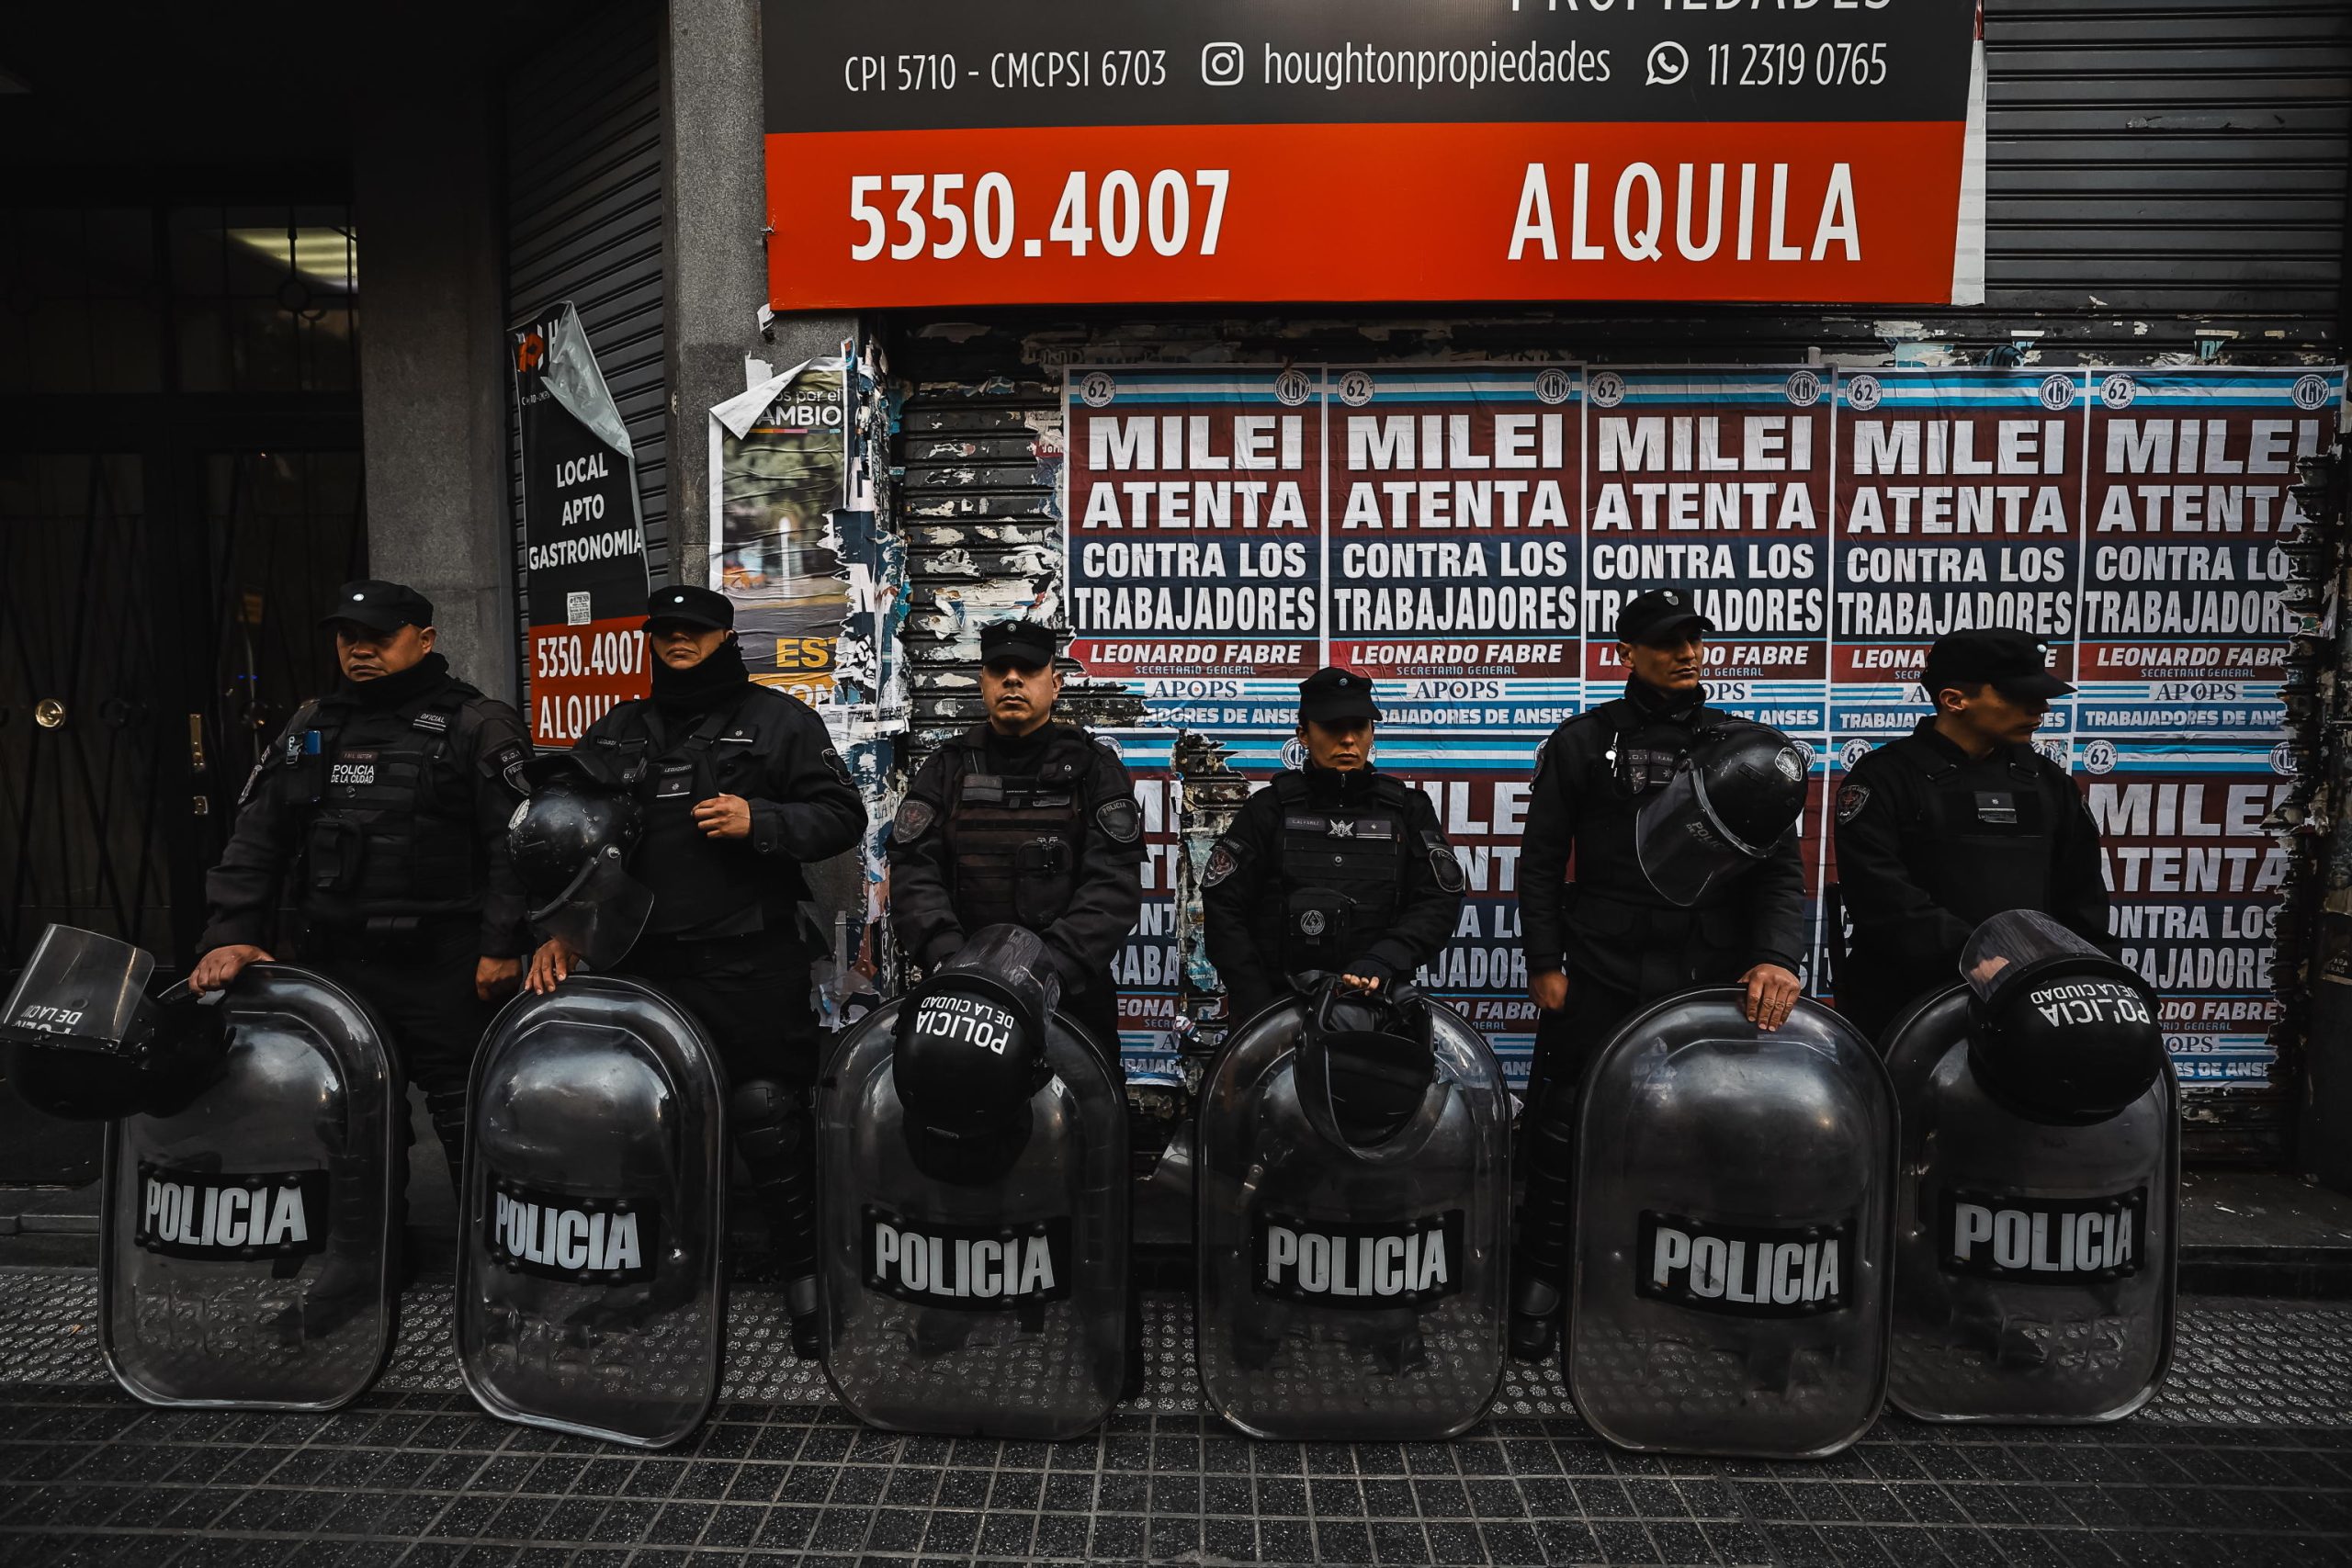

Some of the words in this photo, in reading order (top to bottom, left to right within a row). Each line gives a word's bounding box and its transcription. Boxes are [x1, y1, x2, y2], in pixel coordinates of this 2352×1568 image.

[844, 55, 886, 91] CPI
[898, 53, 956, 90] 5710
[991, 51, 1089, 87] CMCPSI
[1102, 50, 1167, 85] 6703
[1265, 41, 1611, 91] houghtonpropiedades
[1708, 44, 1729, 85] 11
[1740, 43, 1804, 85] 2319
[1815, 42, 1887, 85] 0765
[851, 169, 1230, 261] 5350.4007
[1508, 162, 1860, 262] ALQUILA
[796, 390, 824, 404] por
[828, 388, 842, 401] el
[1088, 380, 1107, 398] 62
[1346, 379, 1365, 397] 62
[1598, 380, 1617, 398] 62
[1854, 384, 1872, 401] 62
[2108, 382, 2127, 400] 62
[755, 405, 842, 426] AMBIO
[1088, 415, 1303, 470] MILEI
[1347, 413, 1563, 470] MILEI
[1598, 415, 1813, 471] MILEI
[1853, 420, 2065, 475] MILEI
[2106, 419, 2320, 474] MILEI
[557, 452, 608, 488] LOCAL
[561, 493, 605, 526] APTO
[1081, 480, 1309, 529] ATENTA
[1341, 479, 1569, 529] ATENTA
[1591, 482, 1816, 530] ATENTA
[1847, 486, 2068, 534] ATENTA
[529, 528, 642, 570] GASTRONOMIA
[1082, 542, 1227, 579] CONTRA
[1238, 541, 1306, 579] LOS
[1342, 542, 1488, 579] CONTRA
[1500, 541, 1566, 578] LOS
[1592, 544, 1736, 581] CONTRA
[1747, 543, 1815, 580] LOS
[1847, 547, 1988, 583] CONTRA
[1999, 547, 2065, 582] LOS
[2096, 547, 2234, 581] CONTRA
[2247, 547, 2290, 581] LO
[1074, 586, 1316, 631] TRABAJADORES
[1333, 585, 1577, 631] TRABAJADORES
[1838, 591, 2073, 635] TRABAJADORES
[2085, 590, 2299, 634] TRABAJADORE
[537, 629, 644, 678] 5350.4007
[1090, 644, 1218, 664] LEONARDO
[1224, 644, 1302, 664] FABRE
[1351, 644, 1479, 664] LEONARDO
[1485, 644, 1564, 663] FABRE
[1731, 646, 1809, 666] FABRE
[1851, 649, 1927, 669] LEONA
[2097, 647, 2222, 667] LEONARDO
[2224, 647, 2287, 666] FABR
[1135, 665, 1202, 674] SECRETARIO
[1206, 665, 1256, 675] GENERAL
[1396, 666, 1463, 675] SECRETARIO
[1467, 666, 1518, 675] GENERAL
[1714, 668, 1764, 677] GENERAL
[2208, 668, 2256, 678] GENERAL
[1152, 680, 1238, 699] APOPS
[1413, 681, 1499, 699] APOPS
[2154, 682, 2236, 701] APOPS
[421, 713, 445, 723] OFICIAL
[1223, 707, 1248, 723] DE
[1251, 707, 1300, 724] ANSE
[1485, 708, 1510, 724] DE
[1513, 707, 1574, 724] ANSES
[1758, 709, 1819, 726] ANSES
[2085, 710, 2220, 727] TRABAJADORES
[2222, 710, 2246, 726] DE
[2251, 710, 2286, 726] ANS
[2090, 749, 2109, 765] 62
[331, 774, 340, 783] DE
[340, 774, 349, 783] LA
[350, 774, 375, 784] CIUDAD
[332, 764, 375, 775] POLICIA
[2088, 784, 2294, 837] MILE
[2099, 846, 2292, 893] TENTA
[2108, 906, 2210, 939] ONTRA
[2121, 947, 2275, 989] BAJADORE
[2030, 984, 2096, 1004] CIUDAD
[2096, 983, 2120, 997] LA
[2118, 985, 2139, 999] DE
[38, 1006, 59, 1021] LA
[921, 996, 971, 1013] CIUDAD
[974, 1002, 993, 1021] LA
[1476, 1001, 1541, 1020] FABR
[2201, 1001, 2278, 1021] FABRE
[55, 1010, 83, 1025] DE
[994, 1010, 1015, 1030] DE
[2184, 1021, 2233, 1031] GENERAL
[915, 1010, 1010, 1055] POLICIA
[2165, 1036, 2213, 1053] OPS
[2198, 1062, 2223, 1077] DE
[2225, 1062, 2268, 1077] ANSE
[144, 1176, 308, 1247] POLICIA
[495, 1191, 642, 1270] POLICIA
[1954, 1201, 2132, 1272] POLICIA
[876, 1222, 1055, 1299] POLICIA
[1267, 1224, 1448, 1297] POLICIA
[1655, 1226, 1838, 1304] POLICIA
